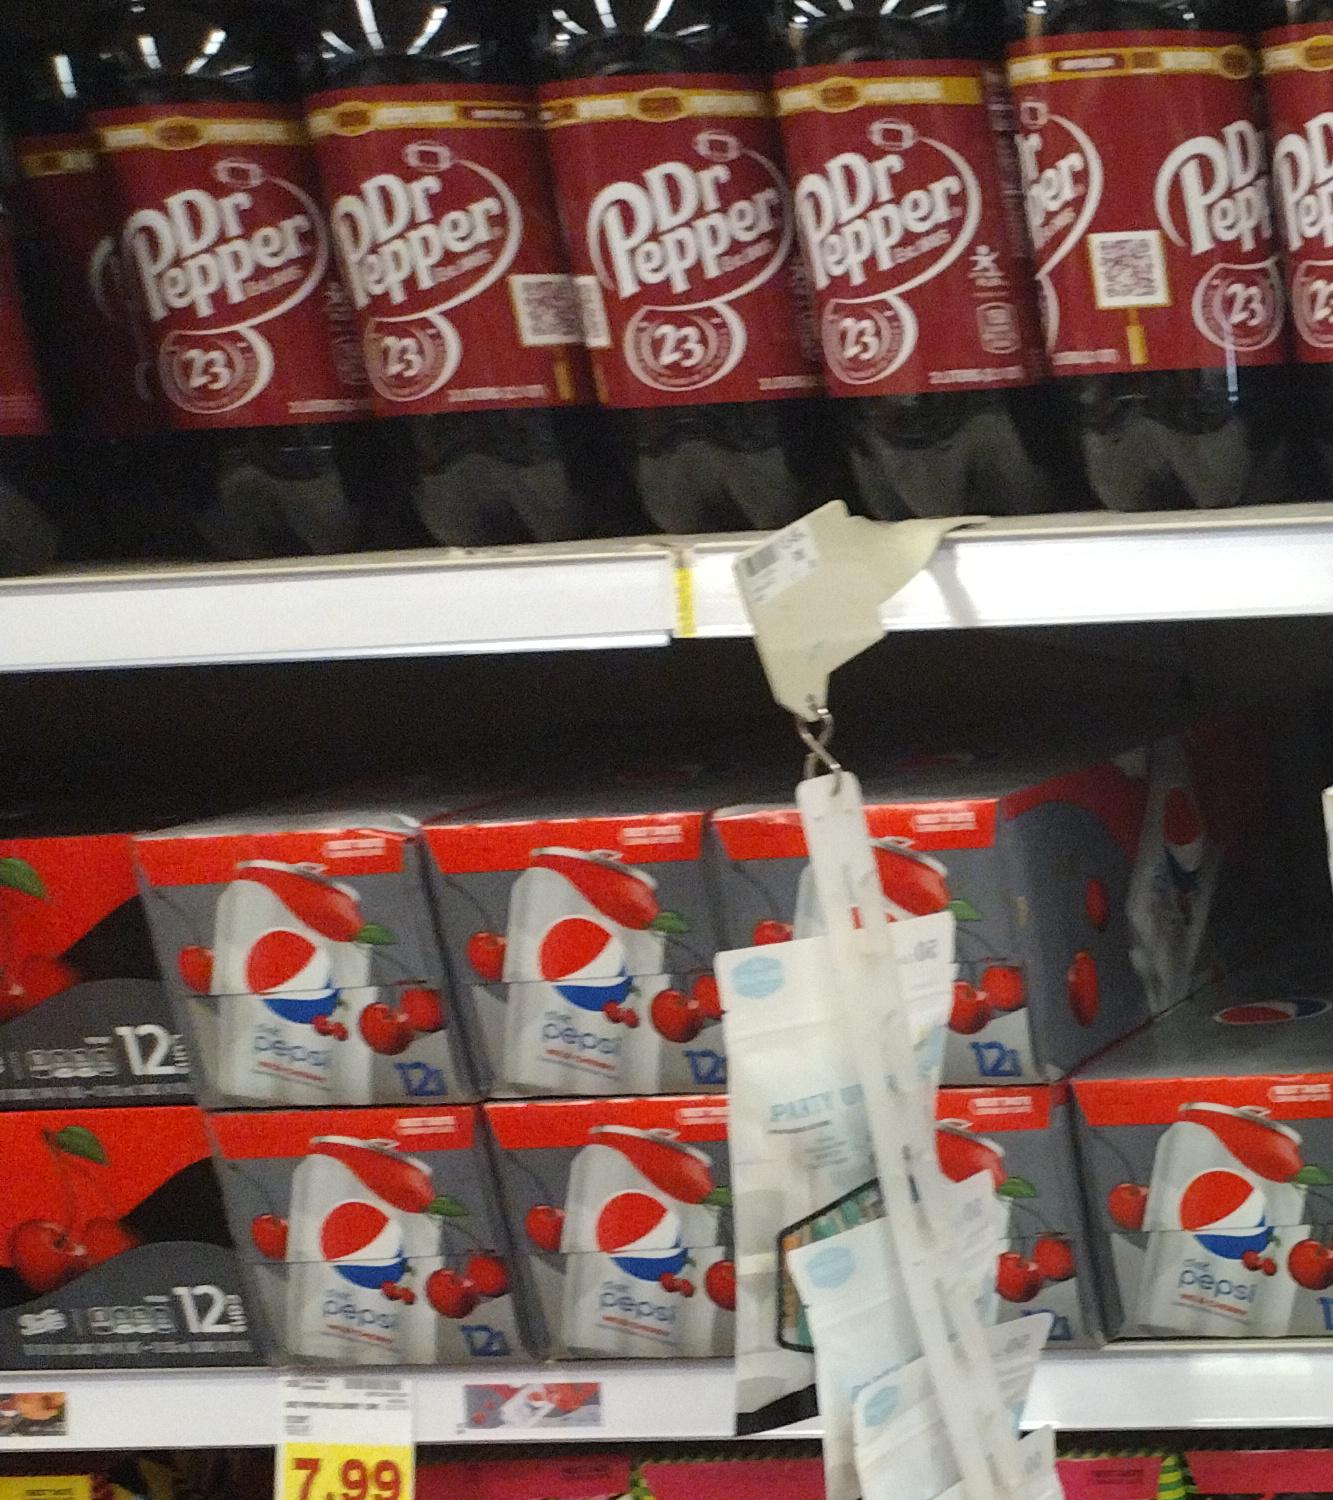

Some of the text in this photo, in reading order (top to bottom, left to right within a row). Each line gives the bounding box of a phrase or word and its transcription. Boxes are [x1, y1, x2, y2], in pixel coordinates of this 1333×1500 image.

[644, 161, 730, 216] Dr
[166, 188, 252, 241] Dr
[590, 181, 778, 298] Pepper
[124, 209, 310, 320] Pepper
[182, 349, 231, 388] 23
[659, 326, 702, 368] 23
[116, 1025, 172, 1075] 12
[174, 1286, 224, 1332] 12
[1178, 1268, 1256, 1305] pepsi
